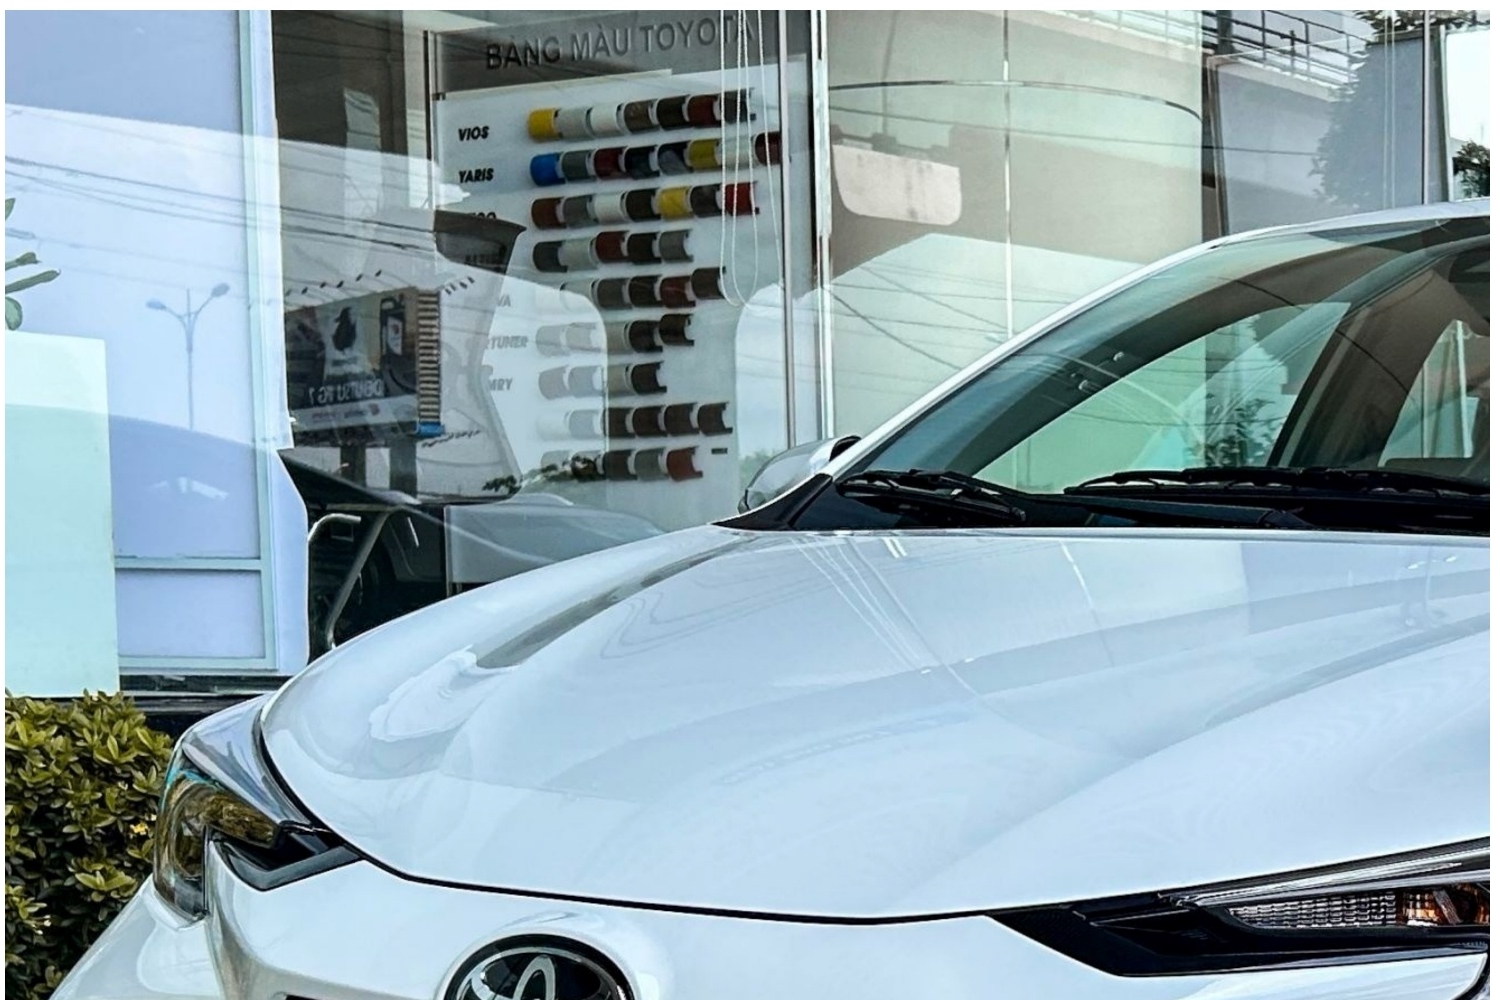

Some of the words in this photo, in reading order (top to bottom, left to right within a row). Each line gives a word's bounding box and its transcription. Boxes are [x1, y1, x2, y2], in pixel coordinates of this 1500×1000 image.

[571, 24, 631, 61] MÀU
[639, 14, 755, 54] TOYOTA
[458, 126, 489, 142] VIOS
[458, 168, 494, 184] YARIS
